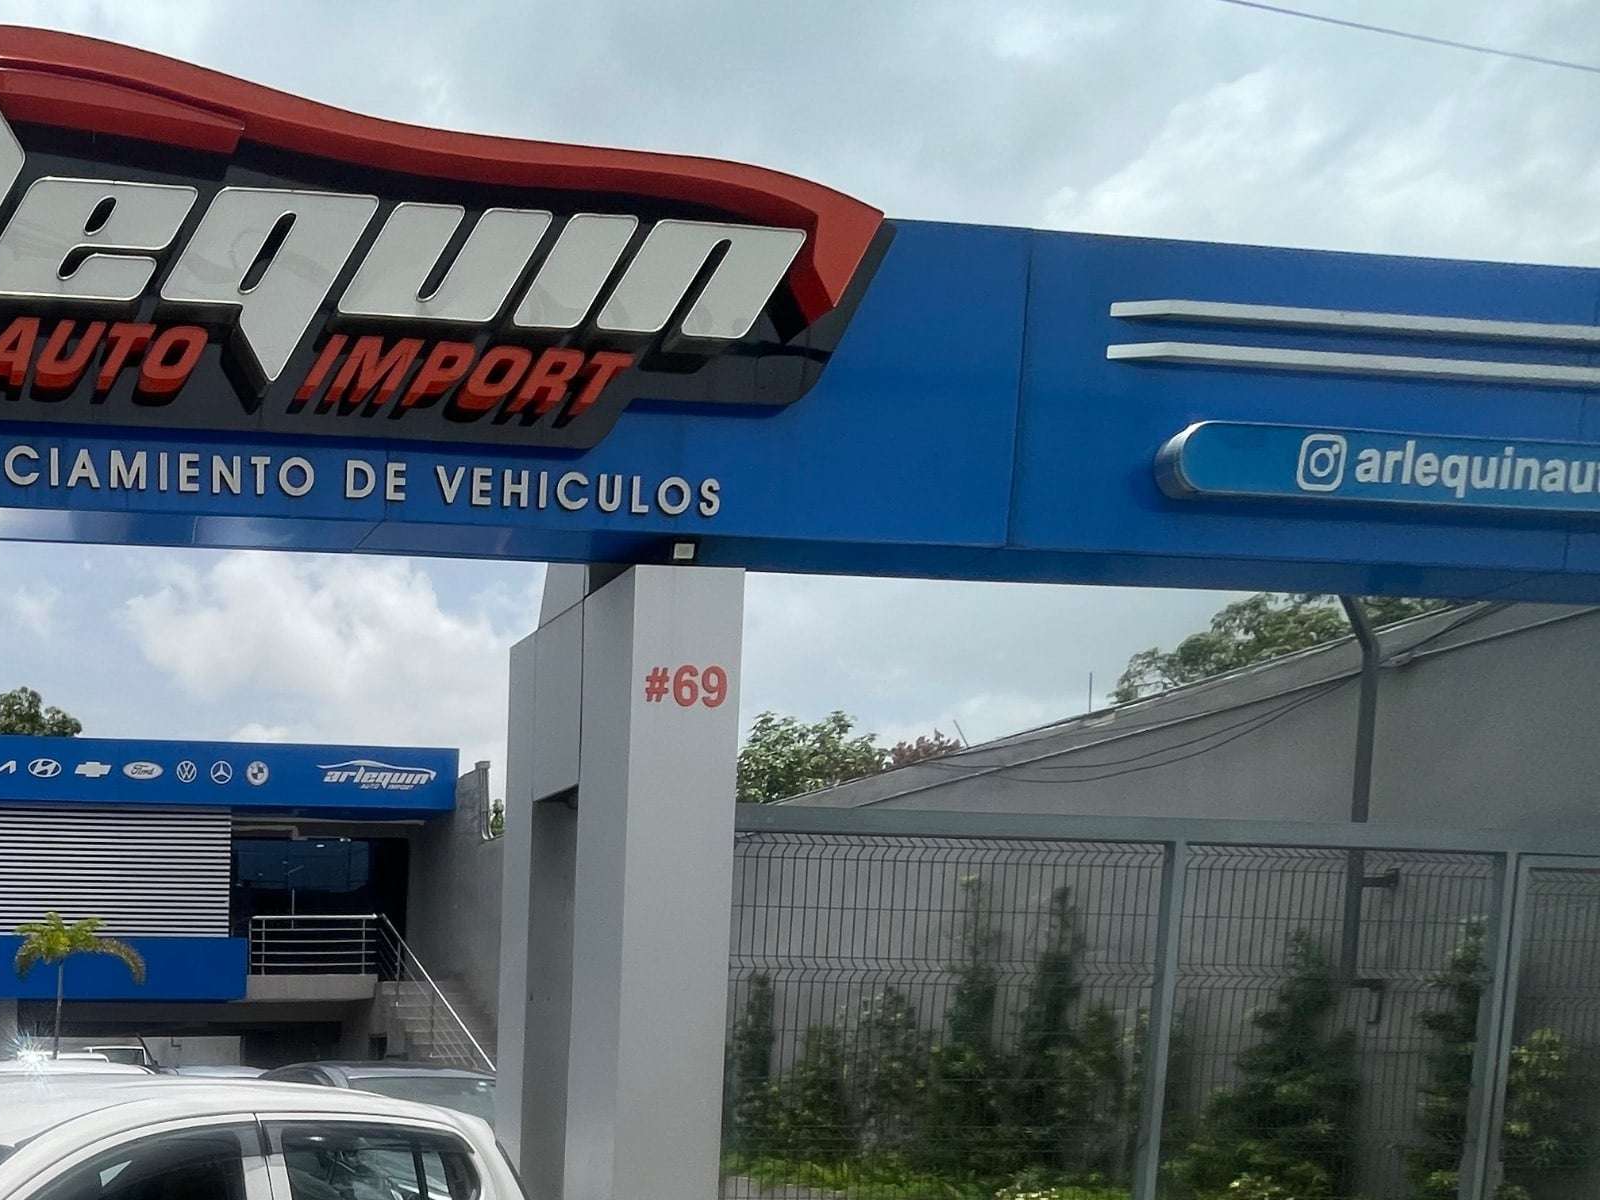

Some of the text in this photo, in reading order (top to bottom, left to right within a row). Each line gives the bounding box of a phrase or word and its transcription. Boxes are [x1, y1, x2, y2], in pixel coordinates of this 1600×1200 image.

[298, 333, 635, 416] IMPORT
[345, 459, 407, 502] DE
[436, 465, 721, 517] VEHICULOS
[1355, 441, 1600, 498] arlequinau
[644, 664, 728, 708] #69
